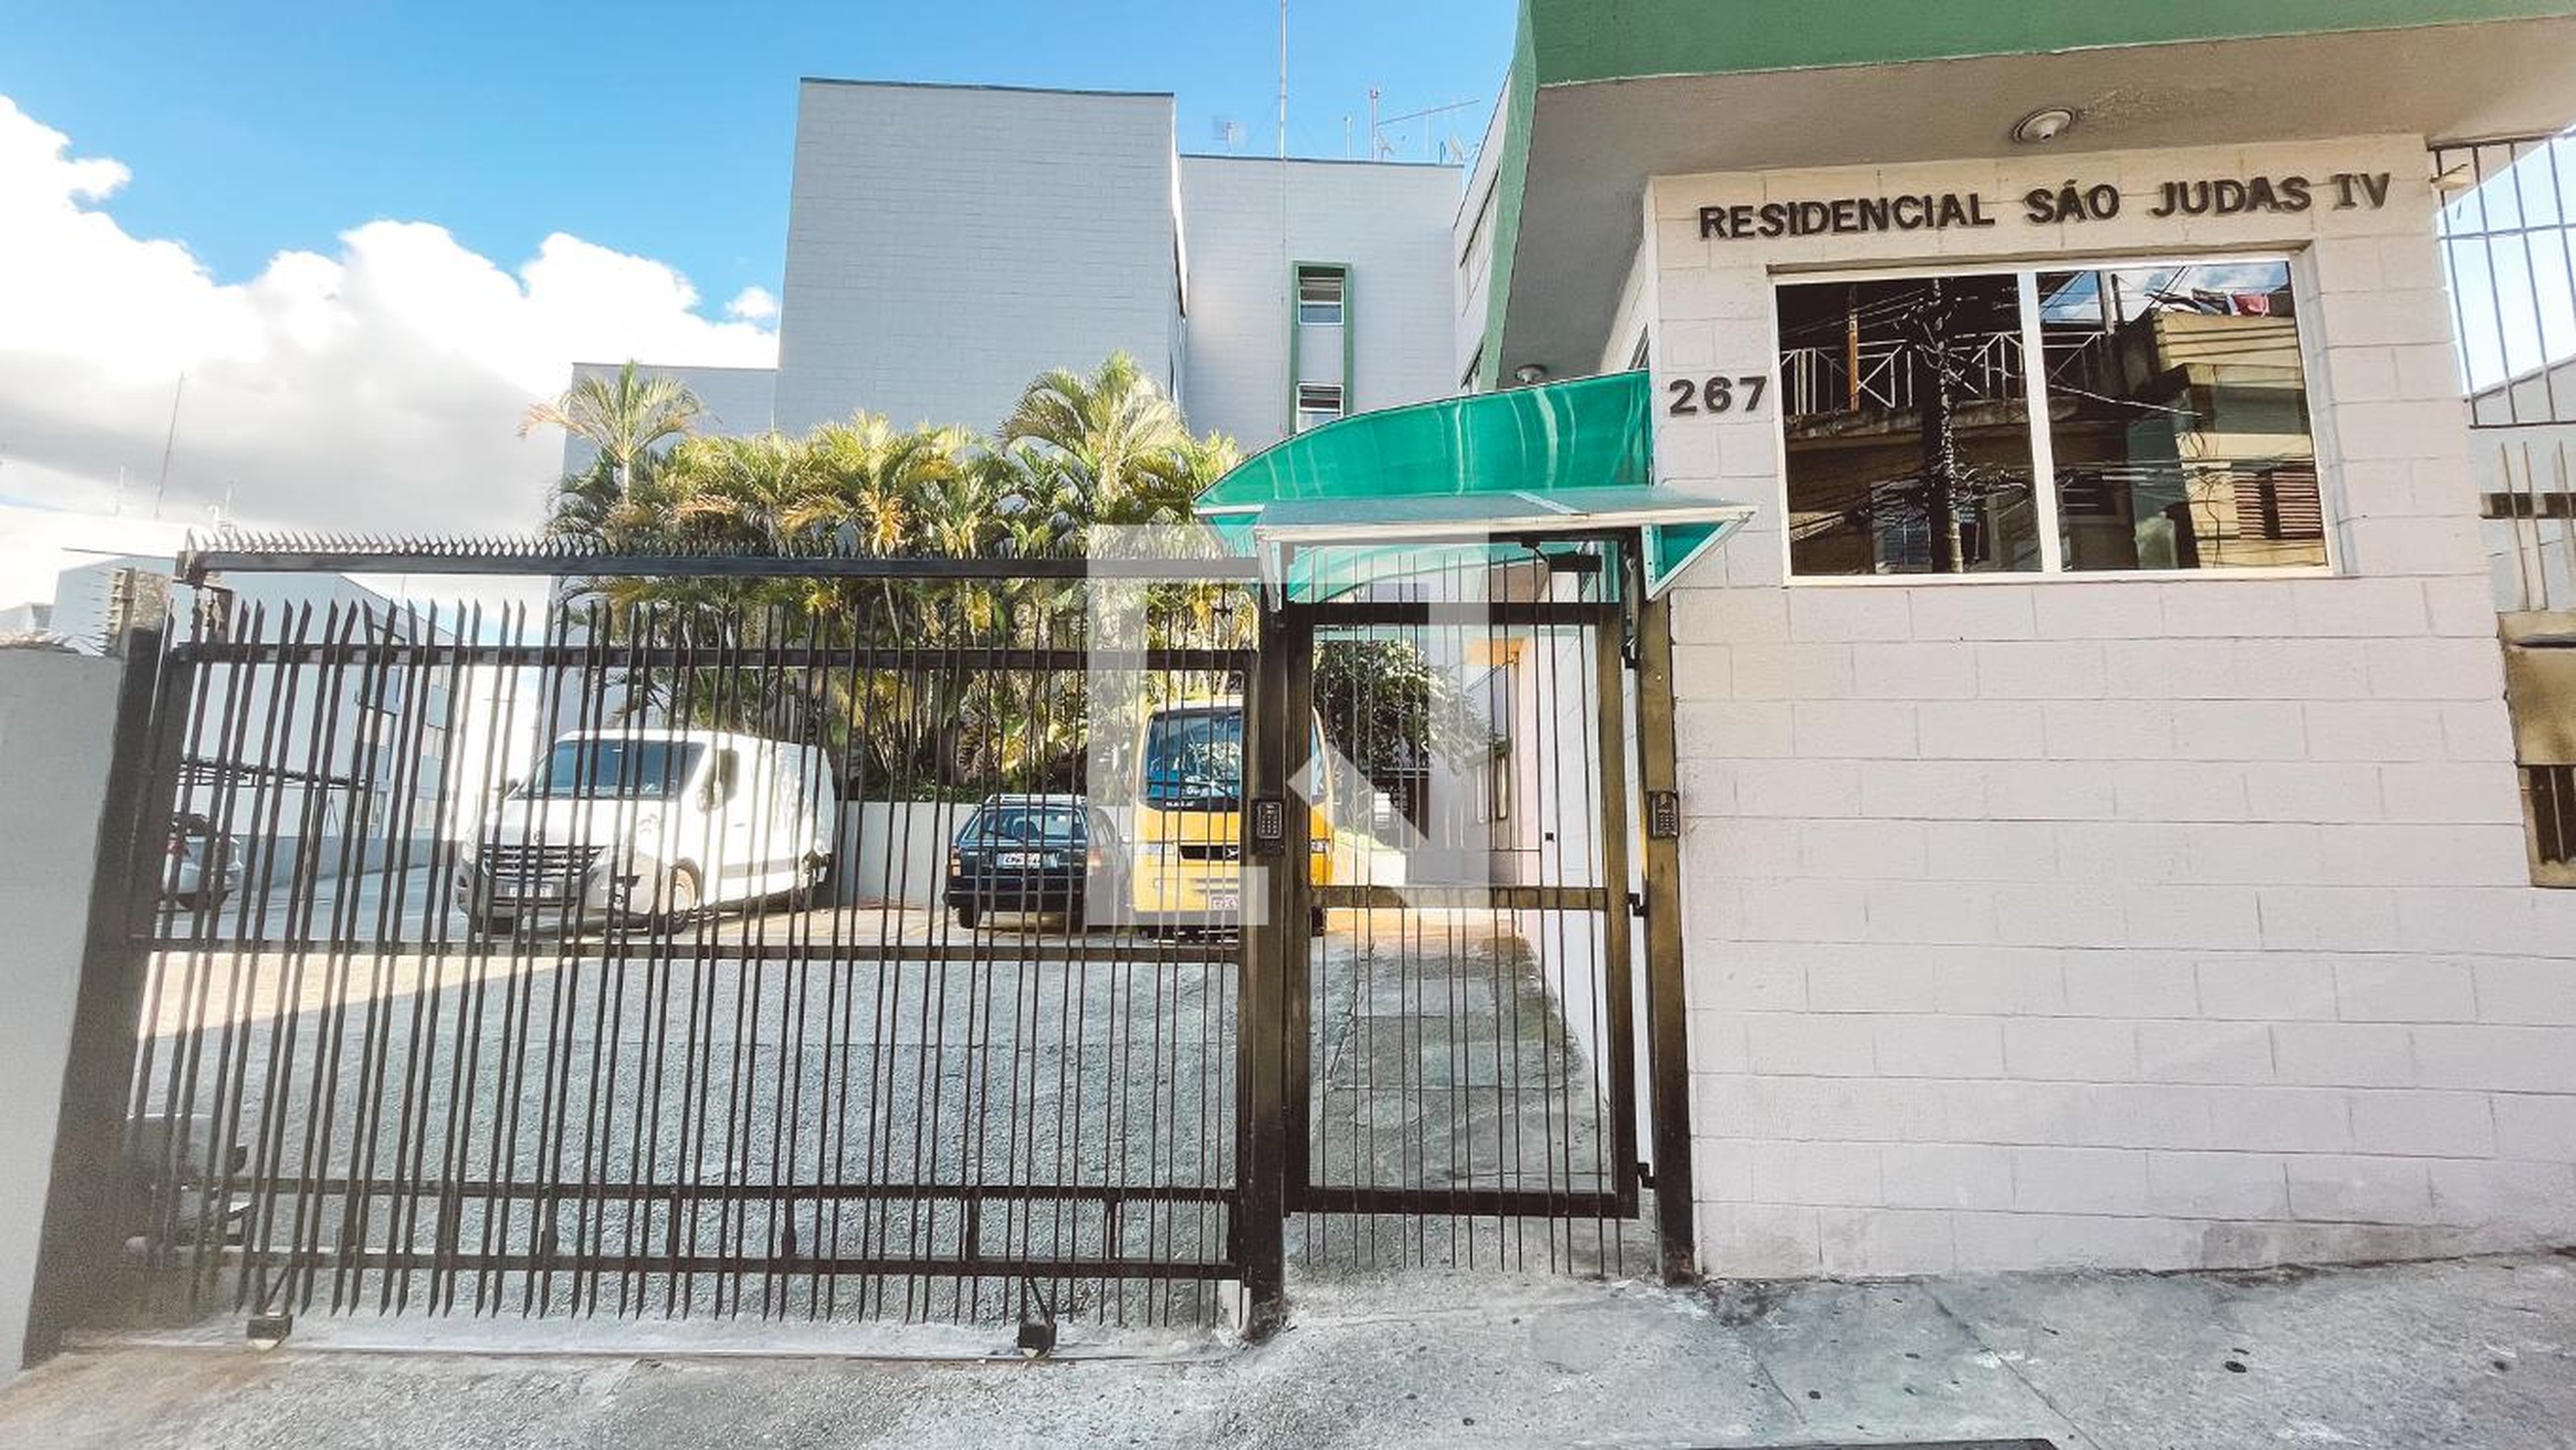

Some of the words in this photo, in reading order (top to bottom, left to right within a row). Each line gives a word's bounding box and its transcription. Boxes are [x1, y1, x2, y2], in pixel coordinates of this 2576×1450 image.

[1699, 193, 1996, 239] RESIDENCIAL
[2151, 176, 2312, 217] JUDAS
[2330, 172, 2390, 211] IV
[1669, 376, 1767, 416] 267
